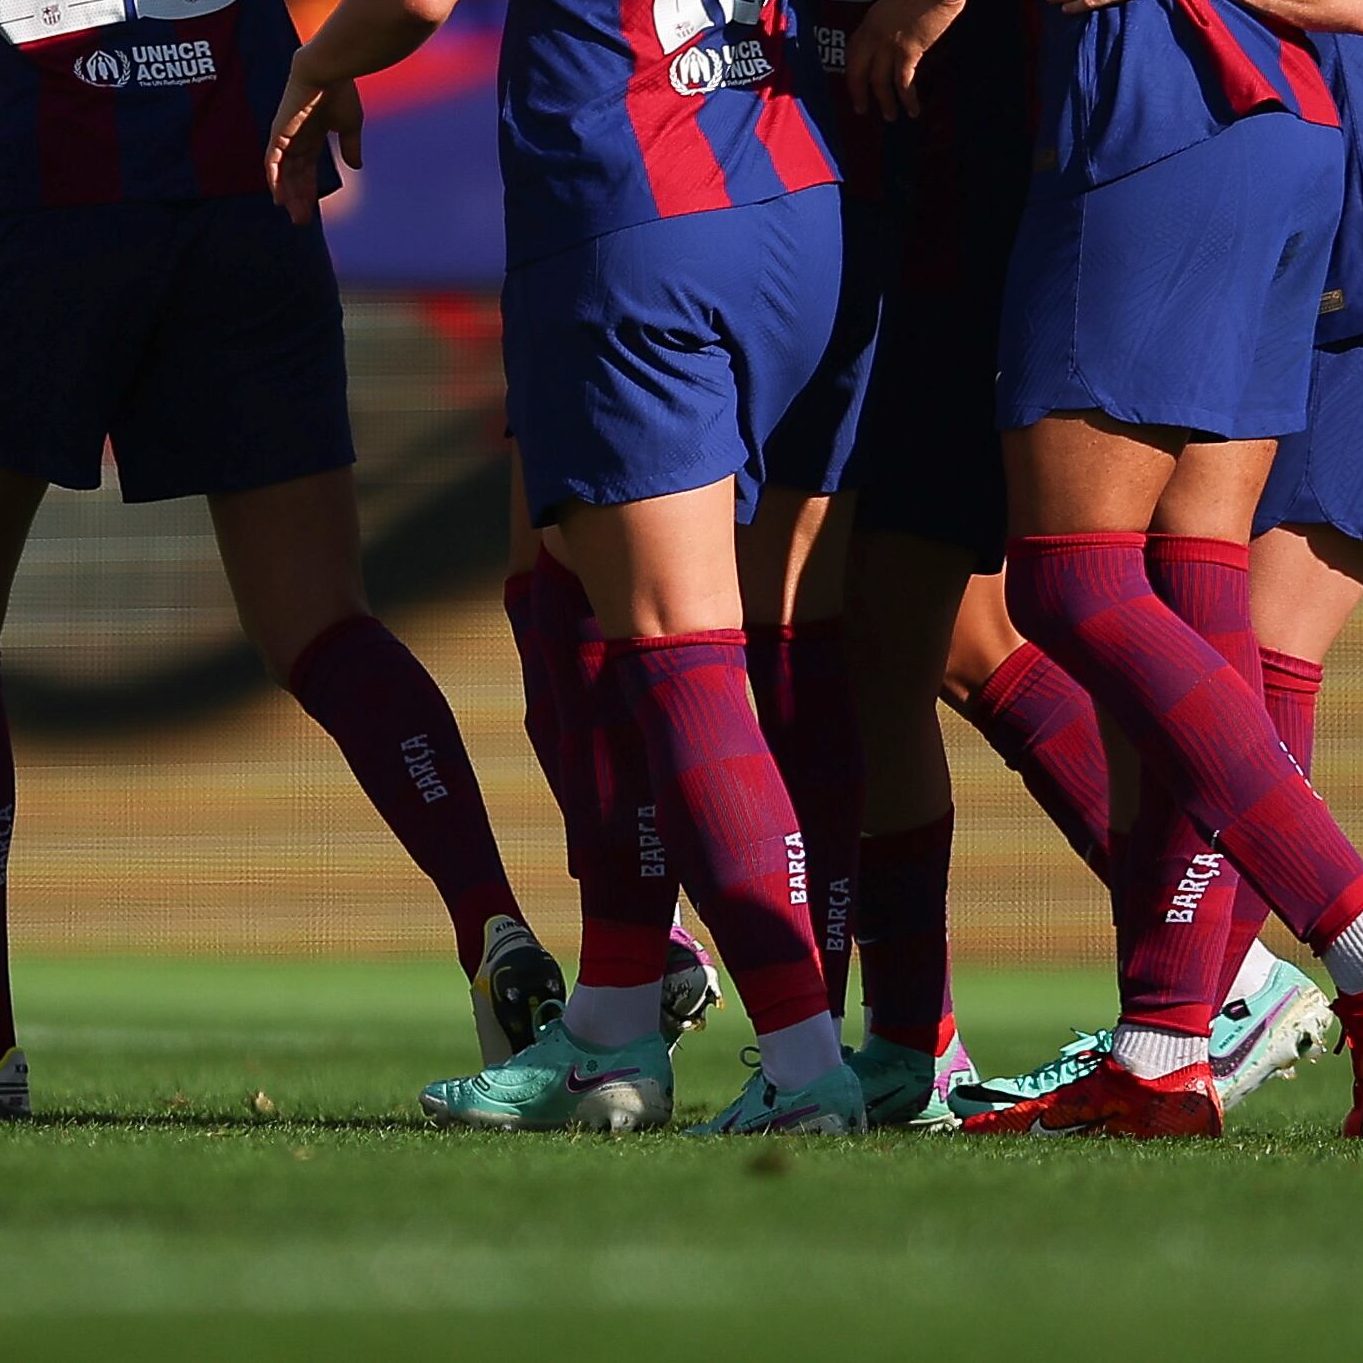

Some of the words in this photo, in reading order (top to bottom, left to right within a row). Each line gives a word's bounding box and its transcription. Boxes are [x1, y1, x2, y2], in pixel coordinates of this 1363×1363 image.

[132, 40, 212, 63] UNHCR
[137, 58, 217, 81] ACNUR
[400, 733, 448, 803] BARÇA
[1164, 853, 1224, 923] BARÇA
